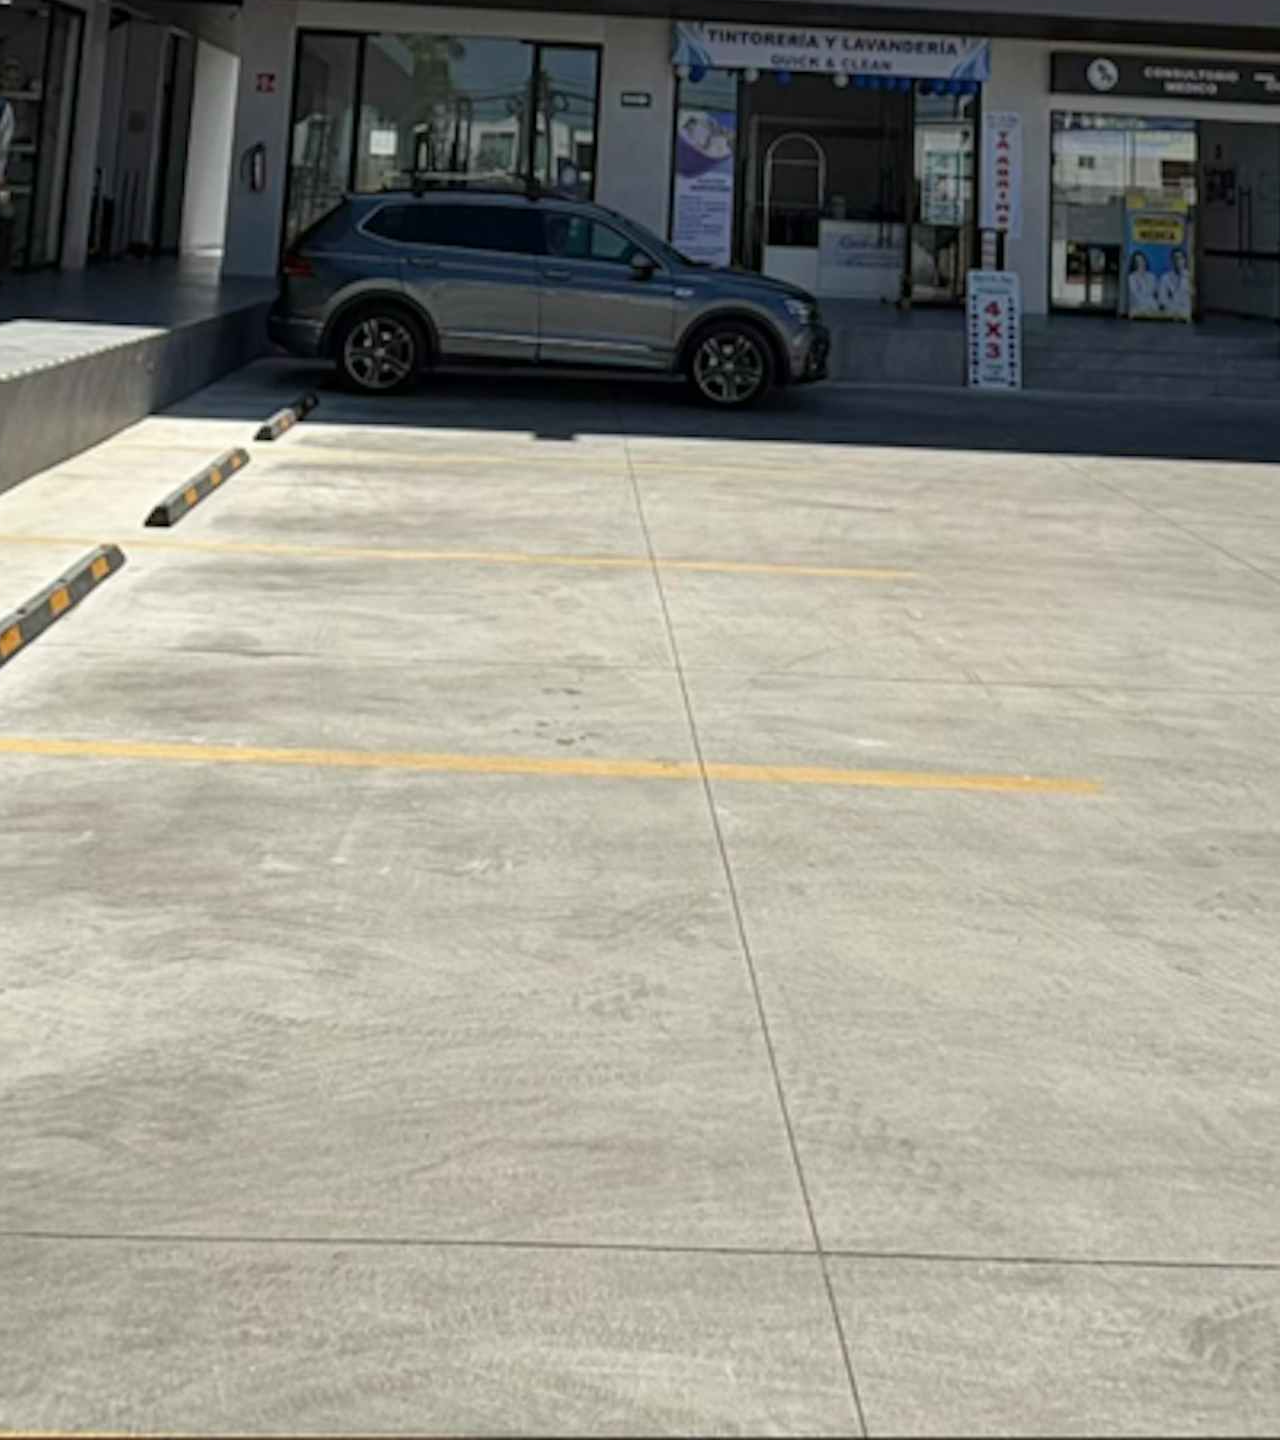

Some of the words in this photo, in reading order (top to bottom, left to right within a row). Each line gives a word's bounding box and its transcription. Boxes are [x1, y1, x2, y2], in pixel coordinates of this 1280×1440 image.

[708, 28, 818, 49] TINTORERÍA
[825, 34, 837, 49] Y
[842, 37, 958, 56] LAVANDERÍA
[770, 53, 819, 67] QUICK
[841, 58, 893, 71] CLEAN
[1143, 65, 1240, 83] CONSULTORIO
